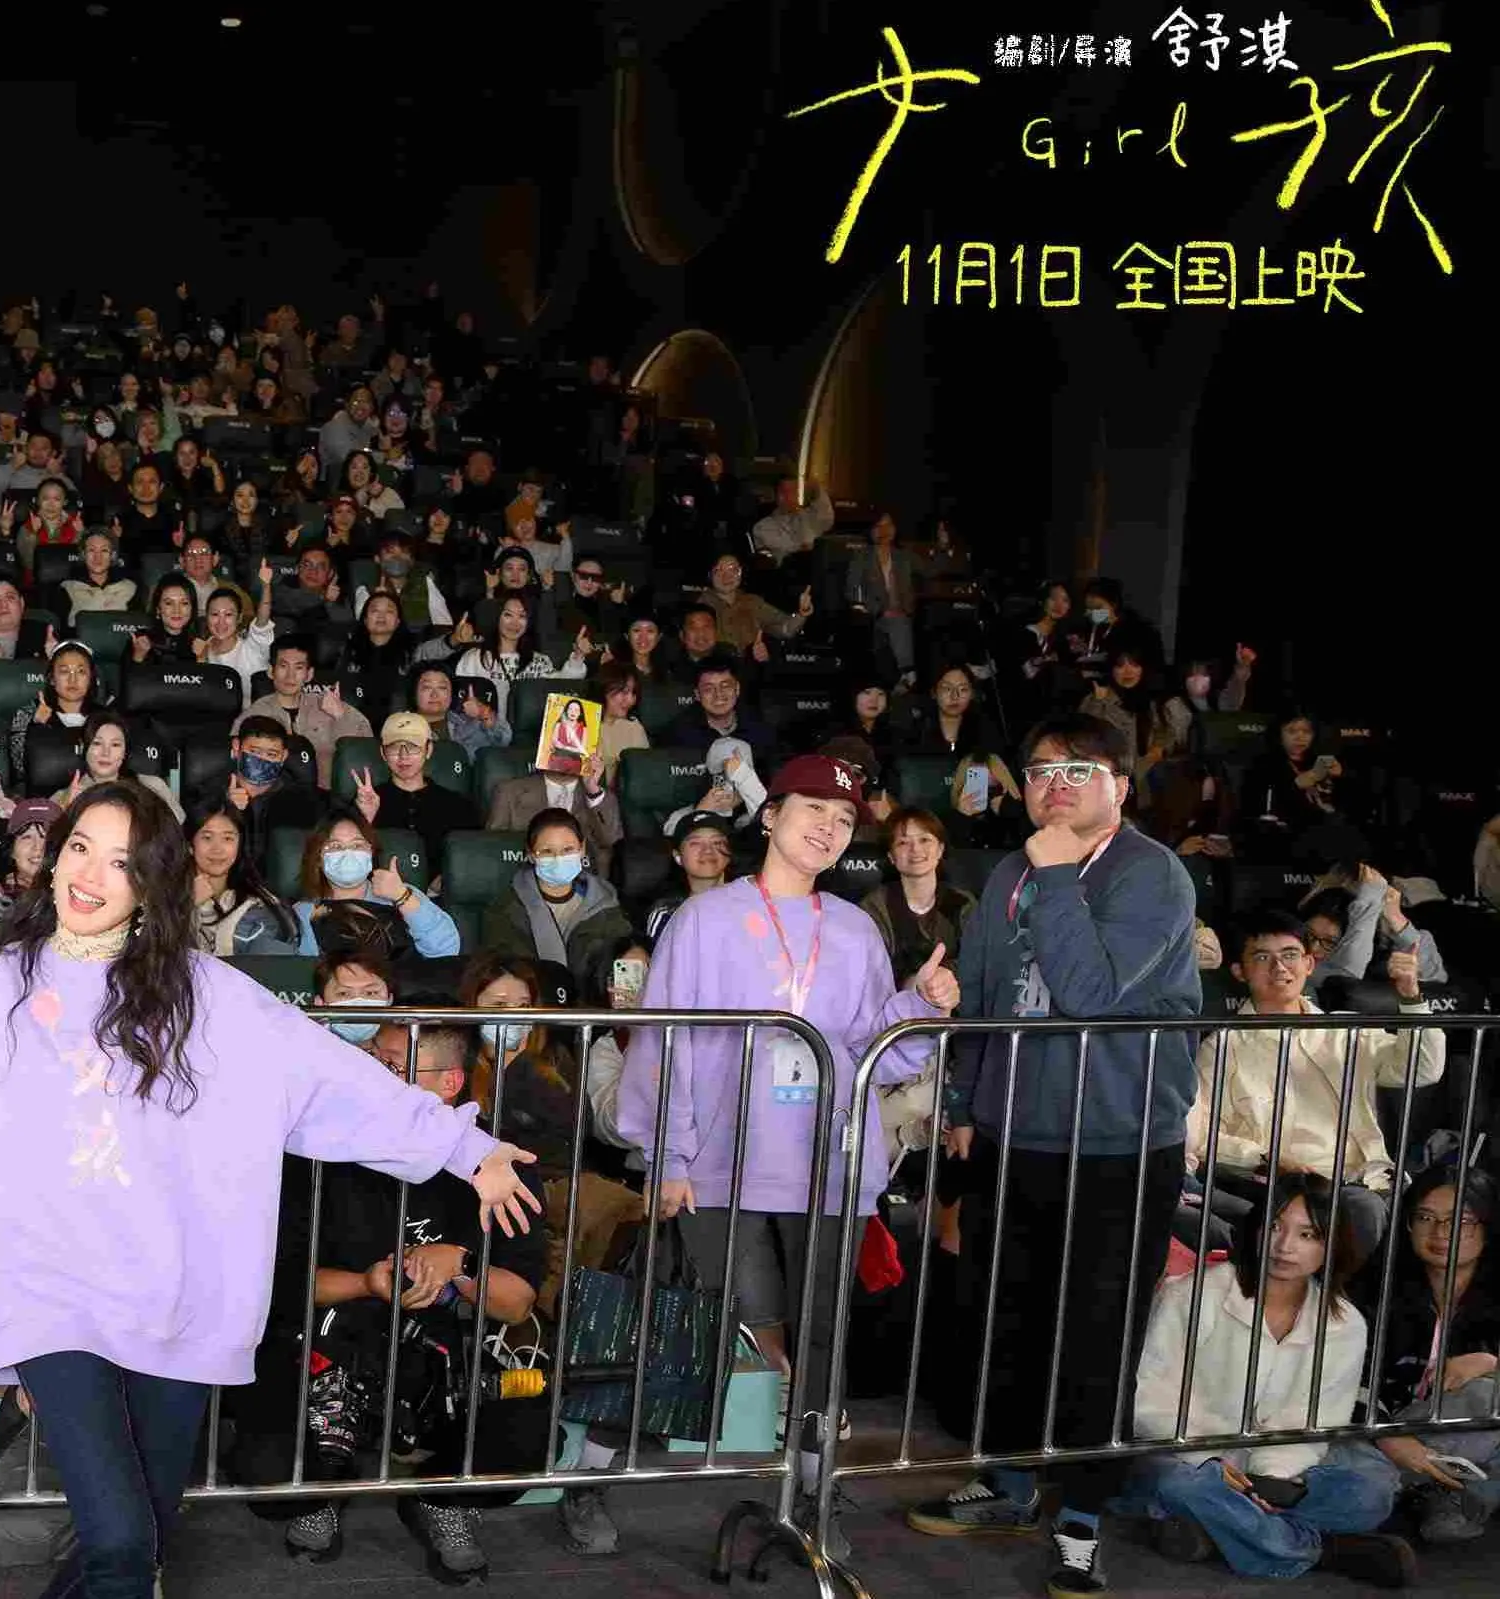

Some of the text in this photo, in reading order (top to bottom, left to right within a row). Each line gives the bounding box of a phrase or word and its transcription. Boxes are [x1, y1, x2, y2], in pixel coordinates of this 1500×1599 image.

[784, 652, 819, 664] IMAX
[163, 674, 233, 694] IMAX 9
[483, 690, 492, 703] 7
[795, 700, 831, 711] IMAX
[1340, 728, 1371, 738] IMAX
[144, 746, 159, 765] 10
[299, 750, 311, 766] 9
[452, 760, 464, 774] 8
[834, 765, 853, 792] LA
[408, 852, 420, 869] 9
[842, 857, 879, 872] MAX
[1282, 873, 1315, 887] IMA
[553, 985, 567, 1005] 9
